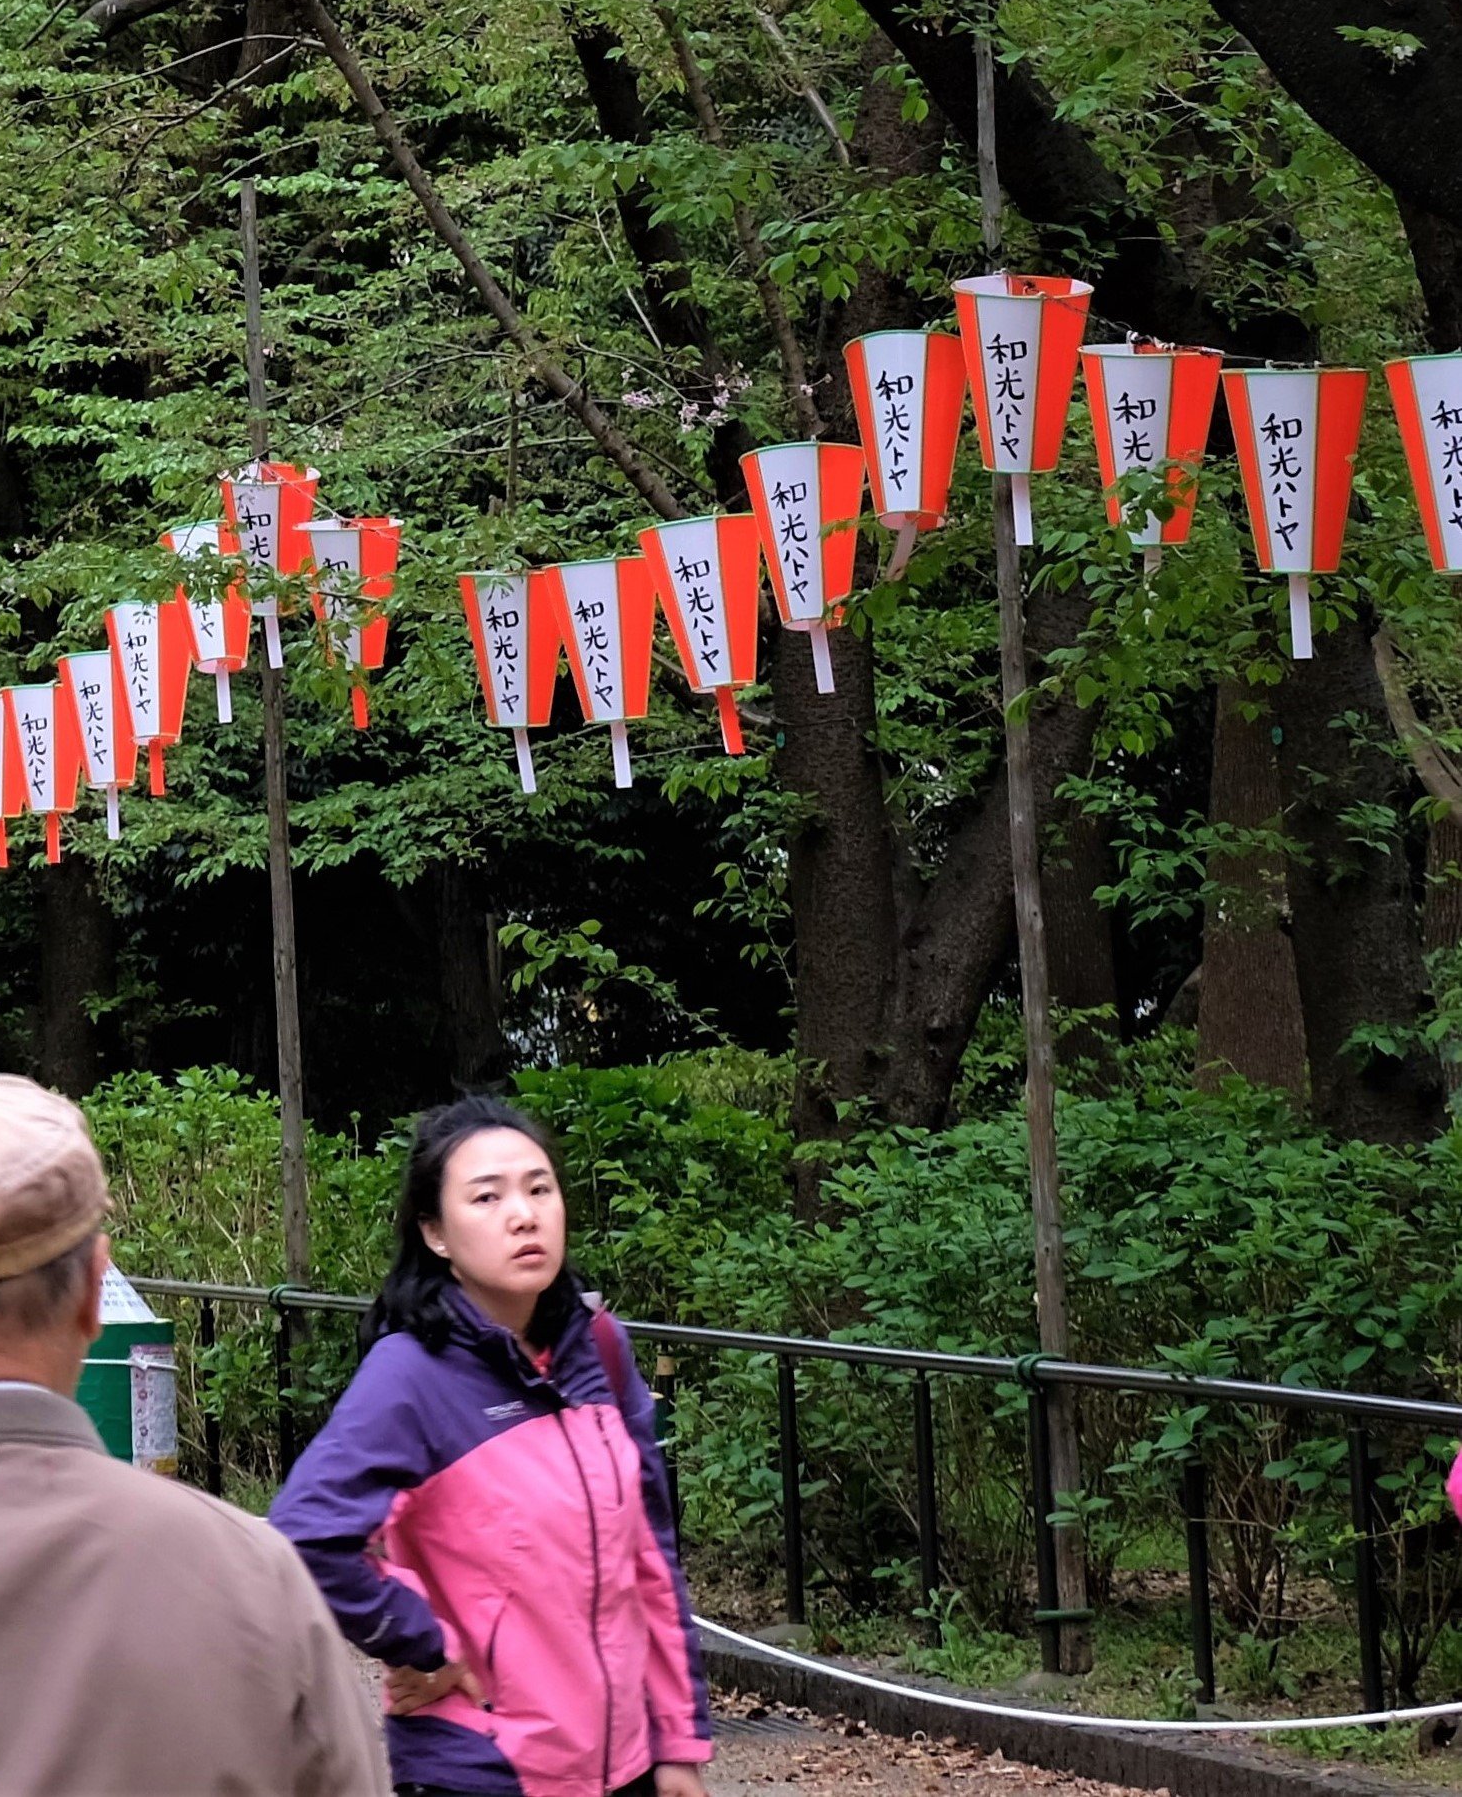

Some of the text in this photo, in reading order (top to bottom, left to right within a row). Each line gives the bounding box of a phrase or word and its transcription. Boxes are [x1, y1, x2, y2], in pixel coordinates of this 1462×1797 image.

[875, 369, 913, 492] 和光ハトヤ
[986, 333, 1027, 460] 和光ハトヤ
[1261, 412, 1303, 554] 和光ハトヤ
[770, 481, 810, 604] 和光ハトヤ
[486, 605, 520, 714] 和光ハトヤ
[574, 598, 614, 709] 和光ハトヤ
[674, 555, 721, 673] 和光ハトヤ
[79, 680, 109, 765] 和光ハトヤ
[124, 632, 152, 715] 和光ハトヤ
[21, 713, 48, 796] 和光ハトヤ
